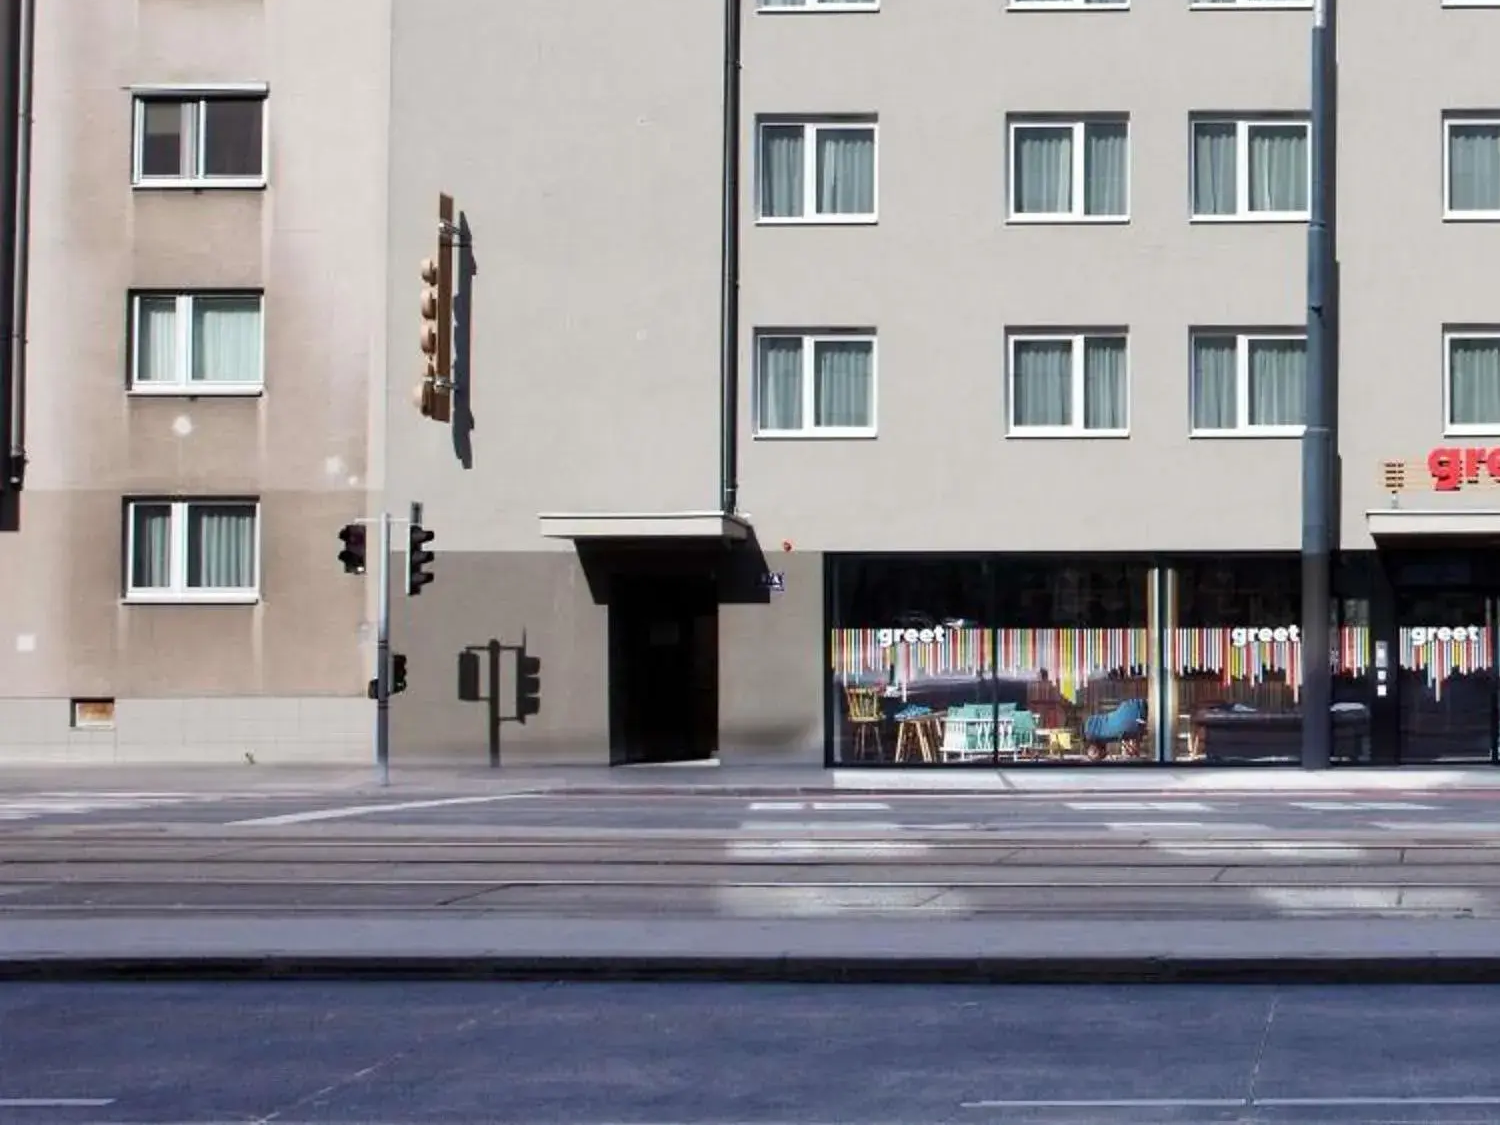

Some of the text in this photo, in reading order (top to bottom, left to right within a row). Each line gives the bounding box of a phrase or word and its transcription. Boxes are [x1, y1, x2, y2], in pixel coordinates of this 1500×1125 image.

[876, 624, 945, 648] greet
[1232, 624, 1299, 647] greet
[1411, 624, 1479, 646] greet
